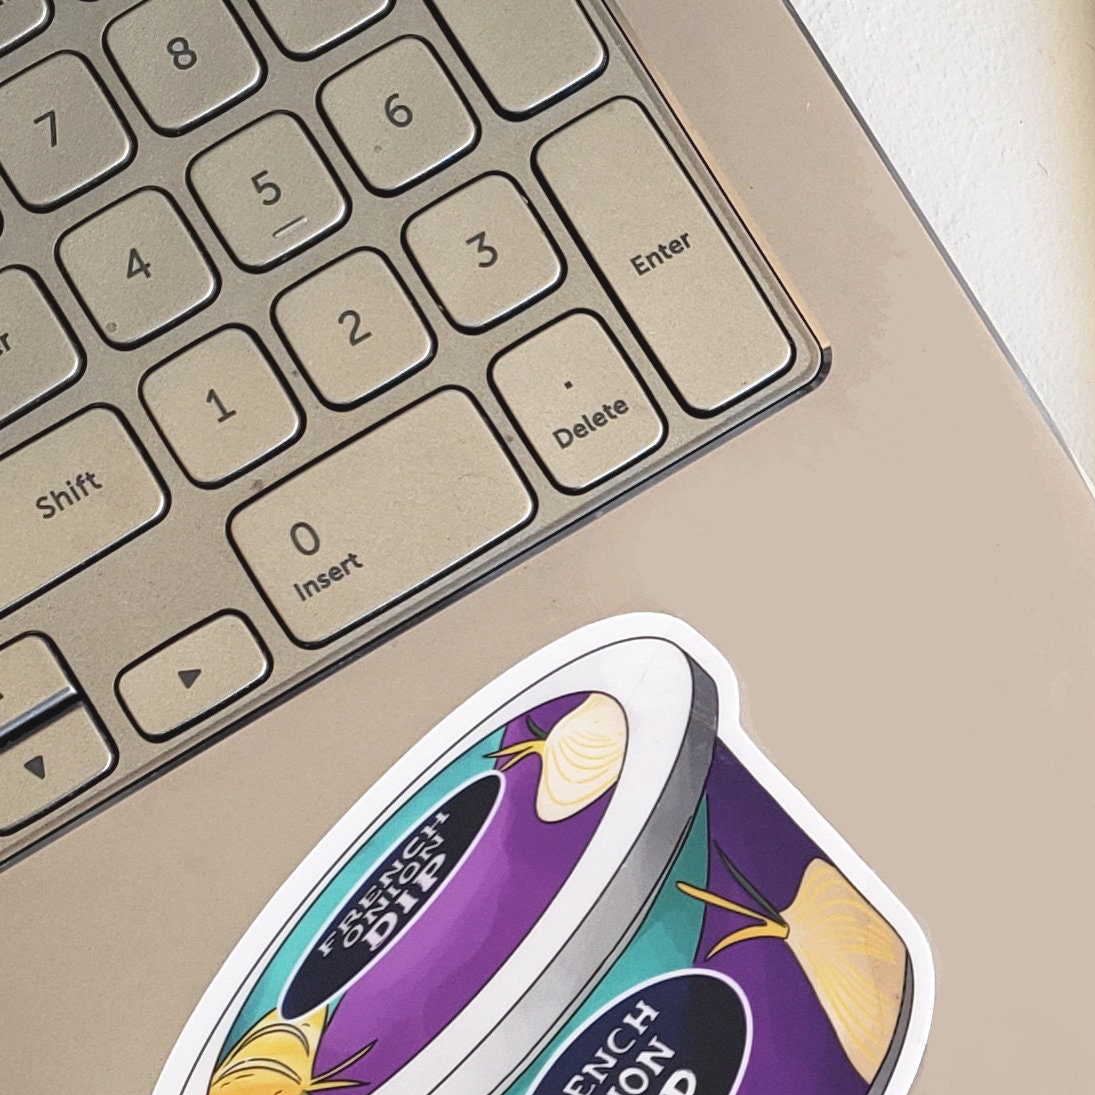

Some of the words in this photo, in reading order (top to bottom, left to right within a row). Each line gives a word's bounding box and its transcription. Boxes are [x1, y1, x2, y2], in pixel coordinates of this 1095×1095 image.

[166, 37, 197, 70] 8
[33, 110, 57, 147] 7
[384, 93, 413, 128] 6
[251, 170, 282, 206] 5
[126, 248, 152, 279] 4
[465, 231, 498, 268] 3
[630, 232, 692, 276] Enter
[338, 310, 372, 346] 2
[205, 389, 236, 423] 1
[552, 397, 630, 450] Delete
[35, 471, 103, 519] Shift
[290, 522, 320, 556] 0
[294, 553, 363, 602] Insert
[317, 811, 450, 958] FRENCH
[343, 833, 445, 948] ONION
[362, 853, 446, 952] DIP
